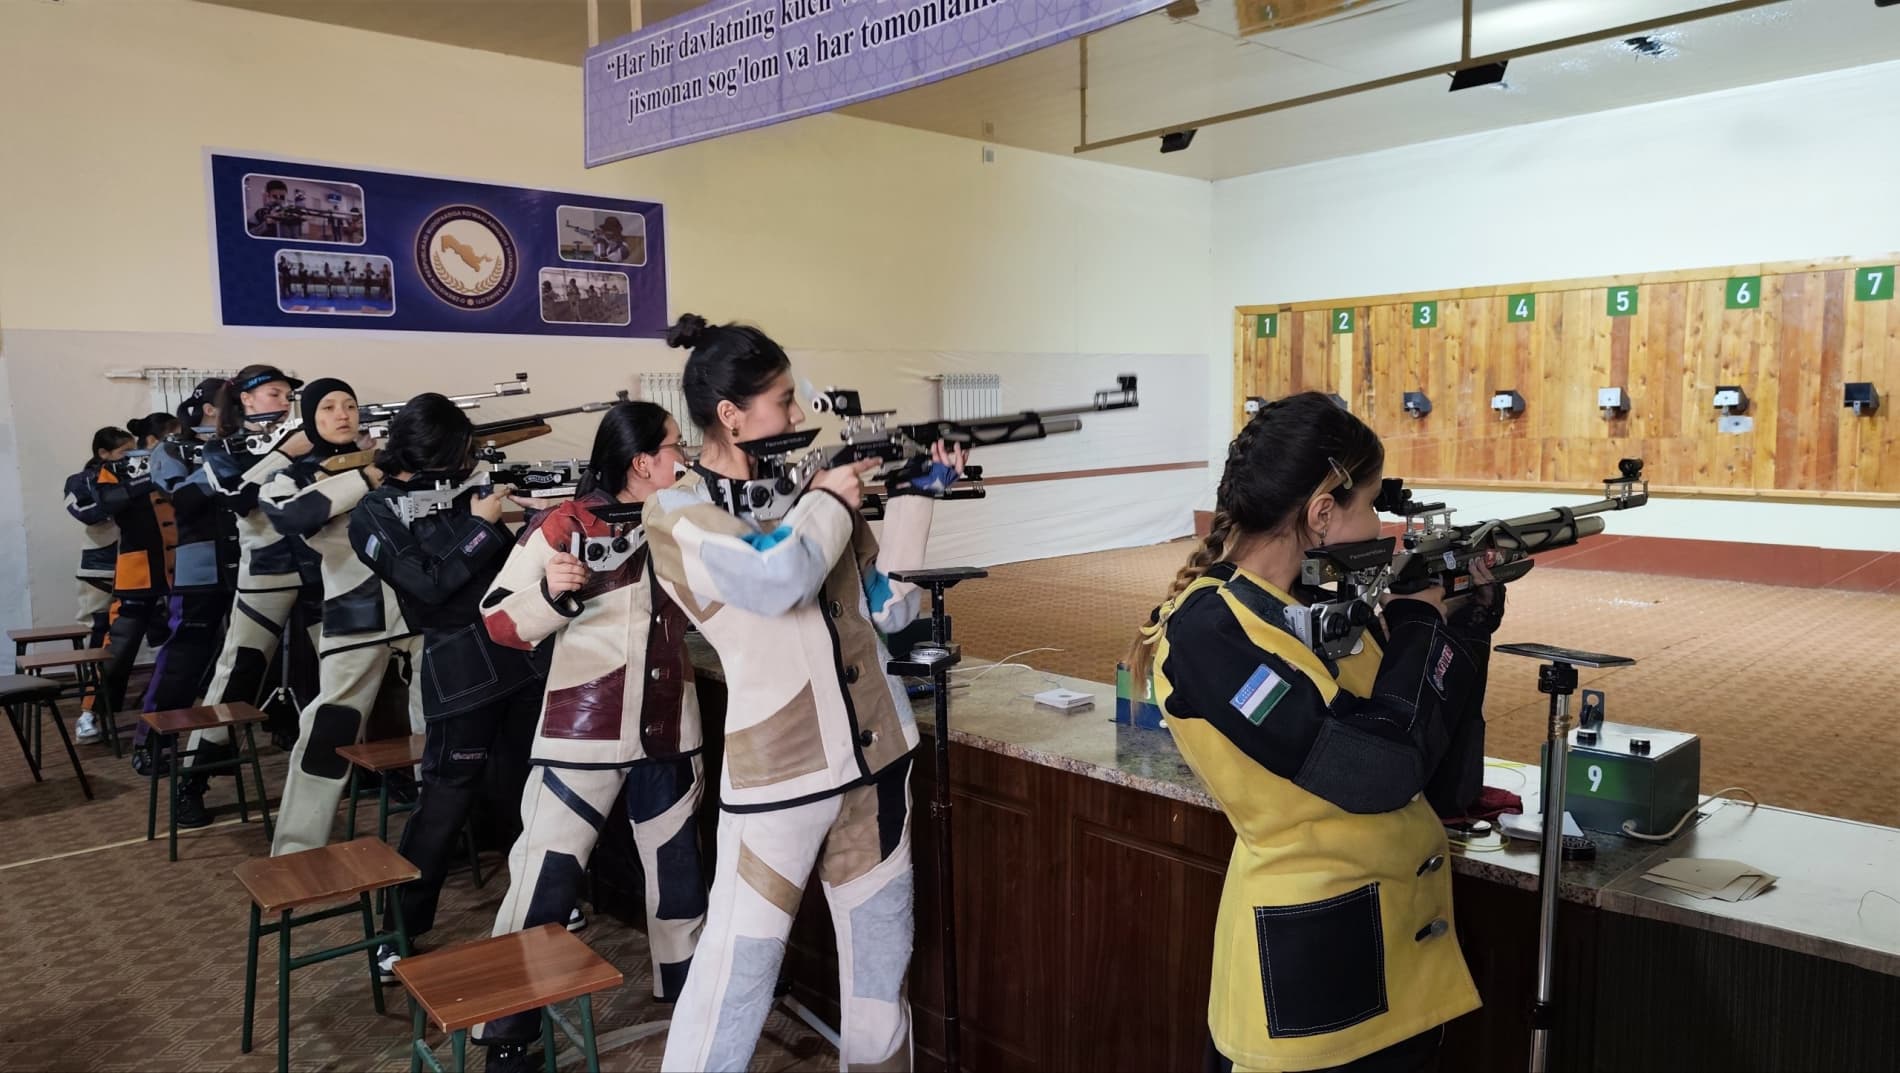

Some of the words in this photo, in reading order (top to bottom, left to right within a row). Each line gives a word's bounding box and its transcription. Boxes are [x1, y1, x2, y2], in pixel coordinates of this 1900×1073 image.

[607, 53, 646, 80] “Har
[651, 40, 674, 68] bir
[679, 9, 776, 59] davlatning
[628, 78, 702, 122] jismonan
[708, 55, 779, 95] sog'lom
[786, 46, 809, 71] va
[816, 31, 854, 63] har
[1736, 282, 1750, 304] 6
[1868, 272, 1883, 295] 7
[1515, 299, 1528, 317] 4
[1616, 291, 1629, 311] 5
[1338, 312, 1348, 329] 2
[1419, 306, 1430, 324] 3
[1264, 318, 1270, 334] 1
[1588, 765, 1602, 792] 9
